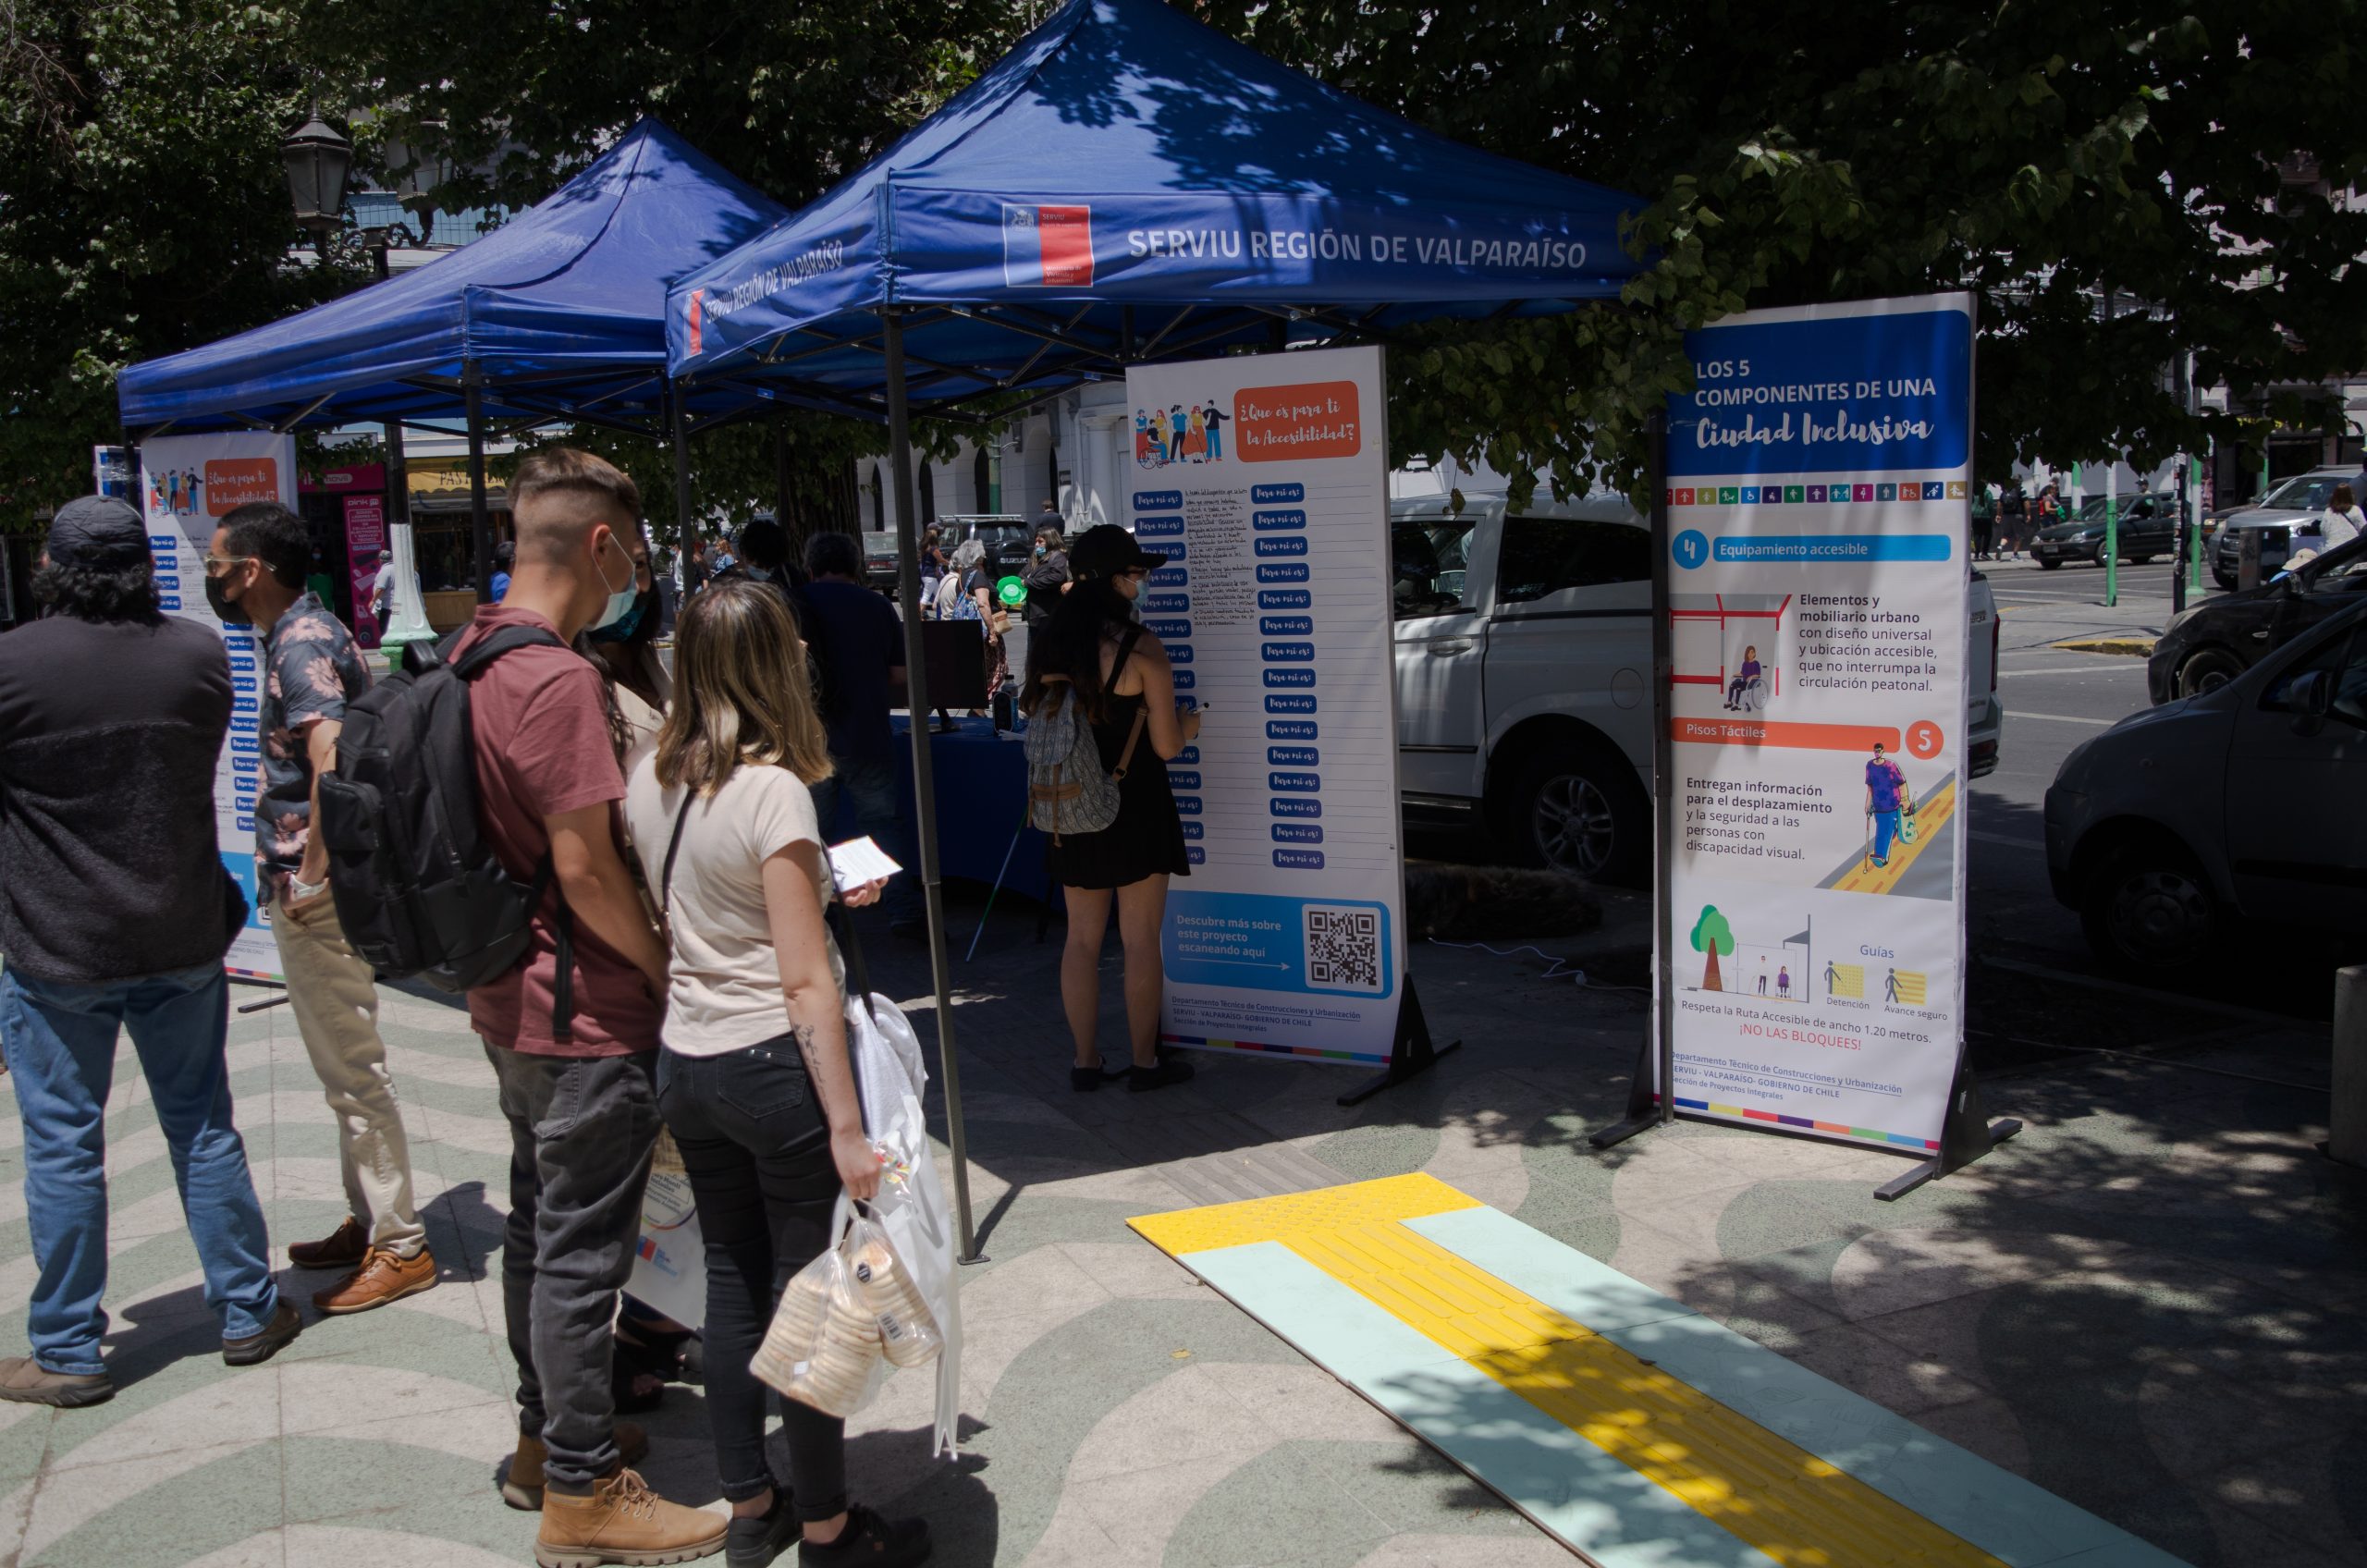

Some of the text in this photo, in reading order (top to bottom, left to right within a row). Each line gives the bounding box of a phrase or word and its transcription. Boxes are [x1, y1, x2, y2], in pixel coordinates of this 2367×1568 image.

[1128, 228, 1587, 269] SERVIU REGIÓN DE VALPARAÍSO
[705, 239, 843, 324] SERVIU REGIÓN DE VALPARAÍSO
[1696, 360, 1749, 379] LOS 5
[1695, 377, 1936, 407] COMPONENTES DE UNA
[1293, 404, 1323, 422] para
[1326, 398, 1341, 414] ti
[1246, 423, 1355, 447] la Accesibilidad?
[1696, 409, 1934, 449] Ciudad Inclusiva
[1684, 539, 1696, 559] 4
[1720, 543, 1868, 559] Equipamiento accesible
[1799, 594, 1880, 609] Elementos y
[1799, 610, 1919, 624] mobiliario urbano
[1799, 627, 1932, 642] con diseño universal
[1799, 643, 1938, 660] y ubicación accesible,
[1799, 660, 1936, 677] que no interrumpa la
[1799, 676, 1932, 692] circulación peatonal.
[1686, 723, 1766, 739] Pisos Táctiles
[1918, 730, 1932, 751] 5
[1686, 777, 1822, 797] Entregan información
[1686, 795, 1833, 814] para el desplazamiento
[1686, 810, 1799, 827] y la seguridad a las
[1686, 826, 1765, 840] personas con
[1686, 839, 1806, 860] discapacidad visual.
[1176, 915, 1282, 932] Descubre más sobre
[1178, 930, 1248, 944] este proyecto
[1178, 943, 1266, 960] escaneando aquí
[1860, 944, 1895, 960] Guías
[1171, 996, 1220, 1008] Departamento
[1220, 999, 1245, 1009] Técnico
[1256, 1003, 1308, 1015] Construcciones
[1315, 1008, 1361, 1019] Urbanización
[1826, 997, 1870, 1010] Detención
[1172, 1008, 1196, 1016] SERVIU
[1245, 1014, 1280, 1024] GOBIERNO
[1293, 1019, 1313, 1027] CHILE
[1682, 1000, 1932, 1044] Respeta la Ruta Accesible de ancho 1.20 metros.
[1884, 1004, 1948, 1022] Avance seguro
[1206, 1020, 1236, 1029] Proyectos
[1740, 1023, 1862, 1051] ¡NO LAS BLOQUEES!
[1672, 1065, 1698, 1075] ERVIU
[1759, 1078, 1801, 1092] GOBIERNO
[1803, 1085, 1813, 1094] DE
[1816, 1087, 1840, 1098] CHILE
[1729, 1059, 1759, 1071] Técnico
[1760, 1064, 1771, 1072] de
[1773, 1066, 1835, 1084] Construcciones
[1846, 1077, 1902, 1094] Urbanización
[1699, 1080, 1709, 1088] de
[1710, 1082, 1746, 1094] Proyectos
